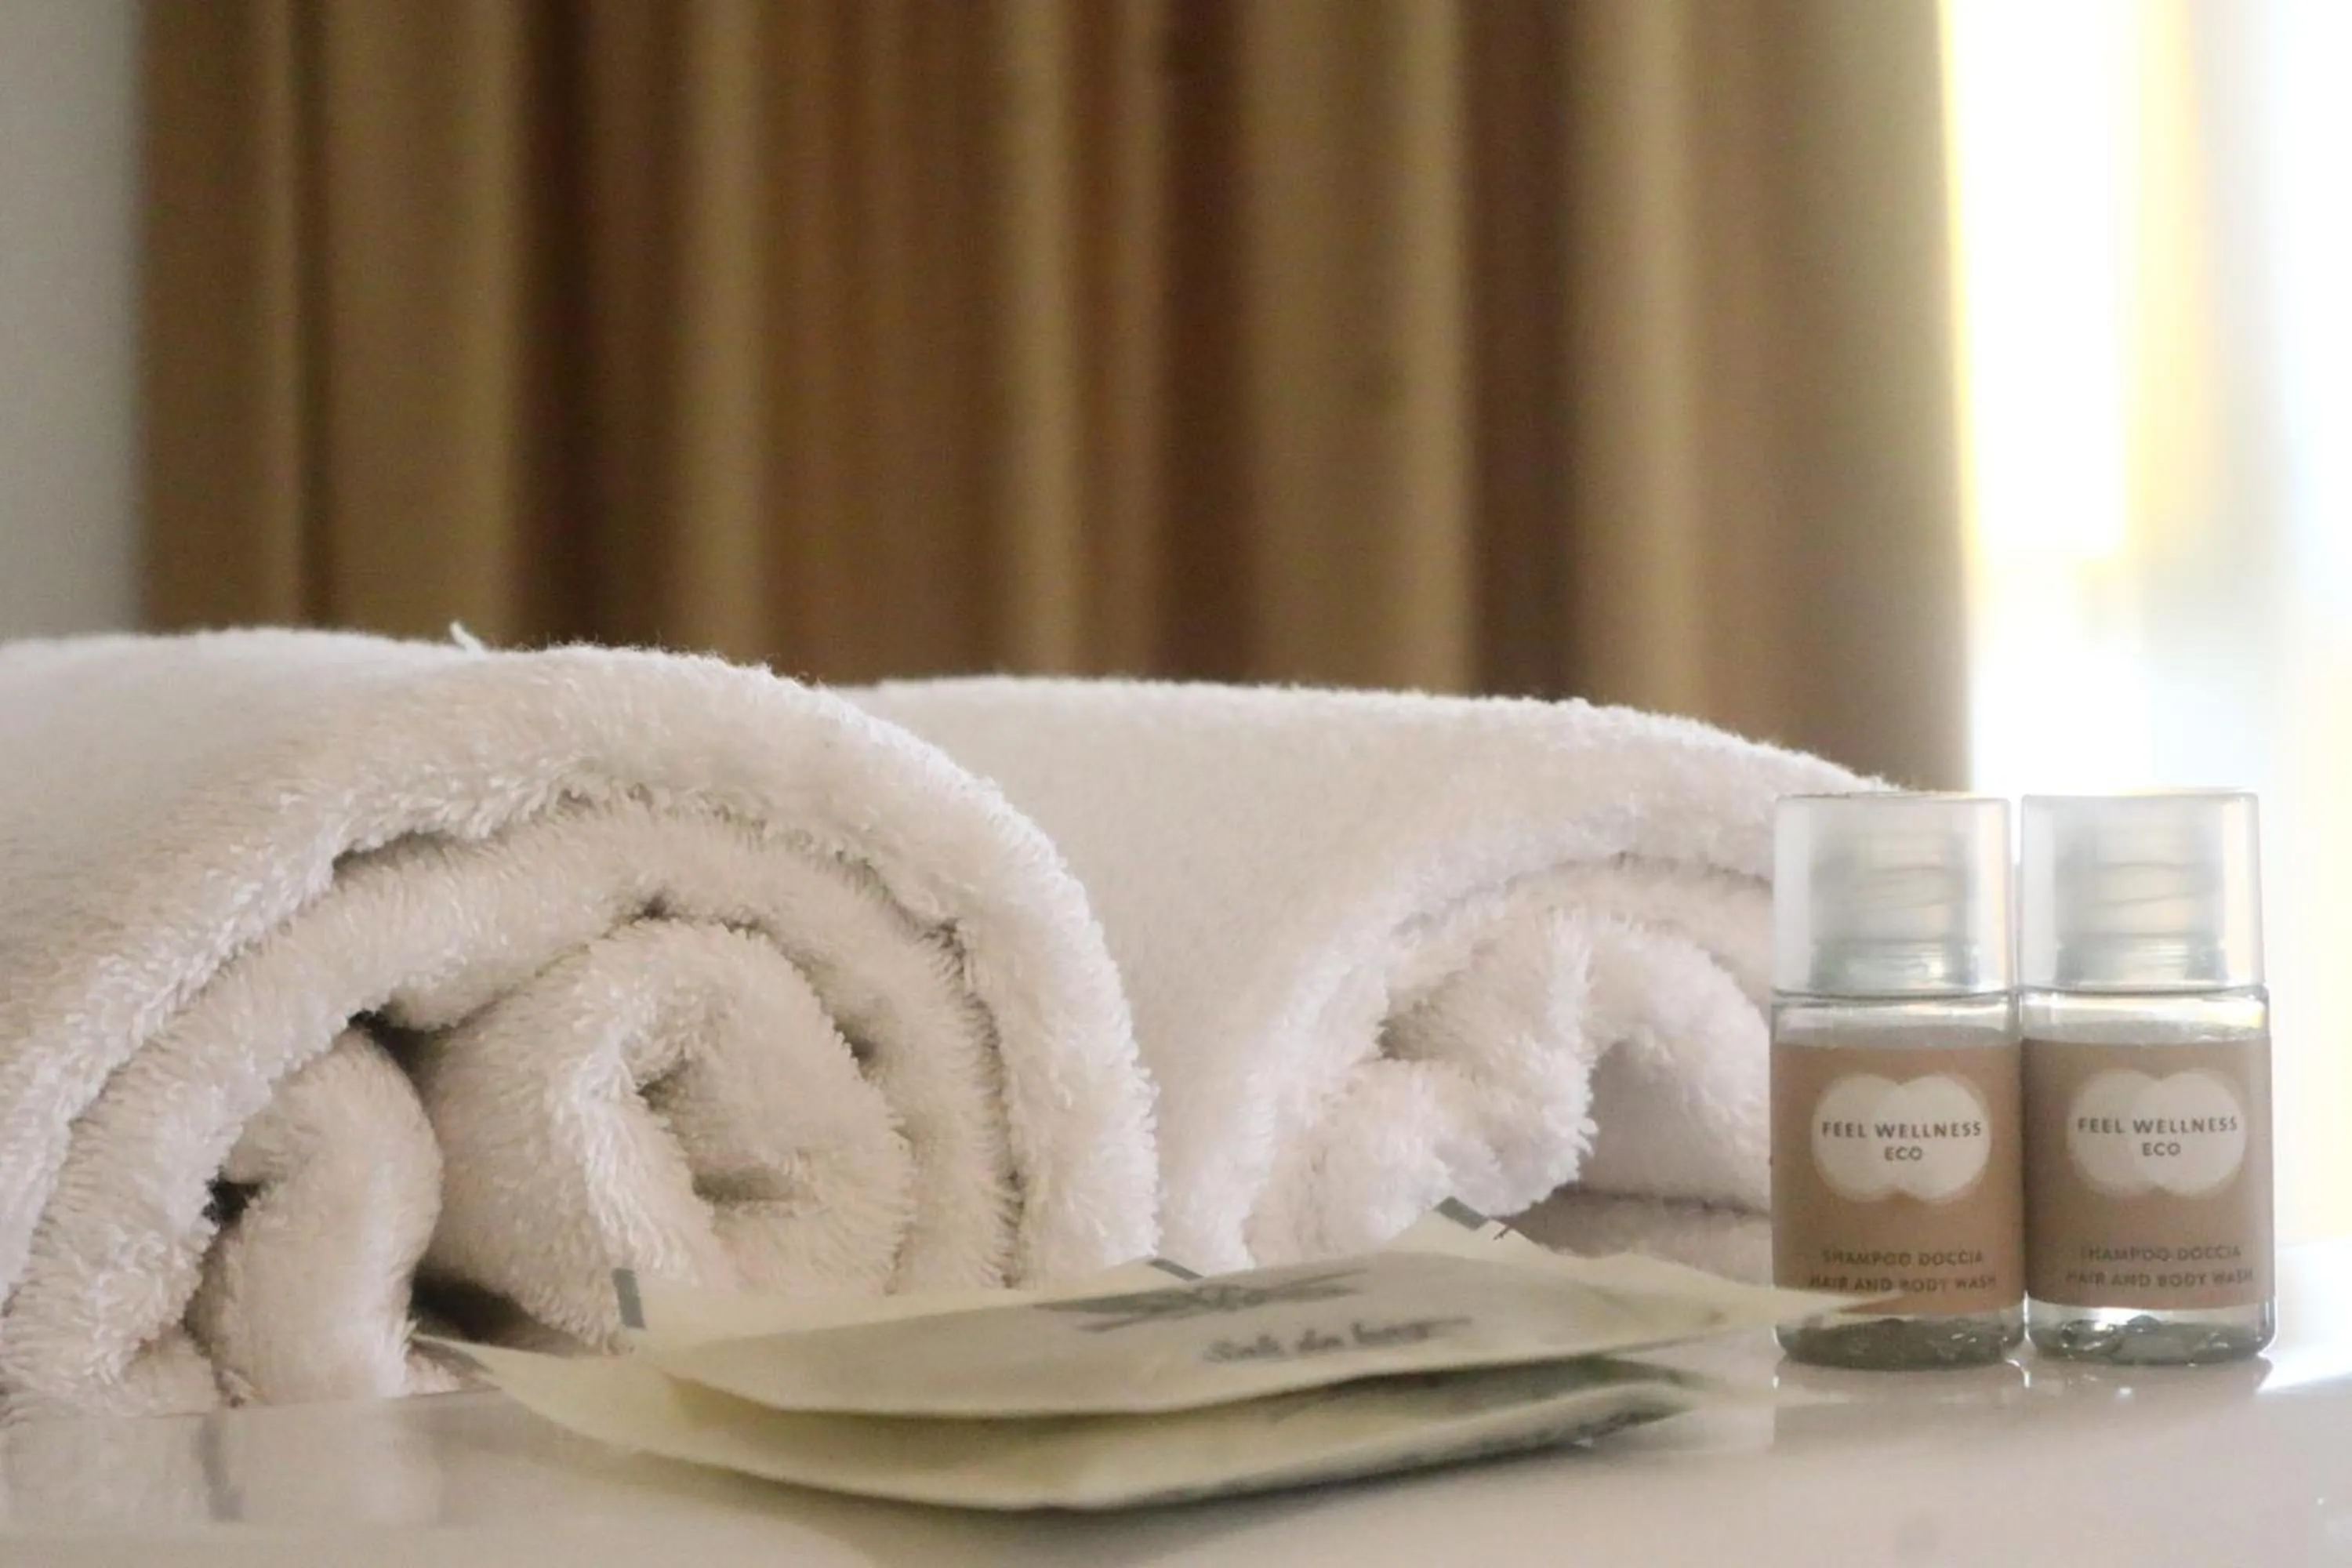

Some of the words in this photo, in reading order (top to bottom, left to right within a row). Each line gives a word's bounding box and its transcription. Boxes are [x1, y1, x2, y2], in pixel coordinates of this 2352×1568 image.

[1821, 1122, 1866, 1138] FEEL
[1875, 1120, 1981, 1138] WELLNESS
[2078, 1116, 2125, 1134] FEEL
[2132, 1116, 2238, 1134] WELLNESS
[1884, 1145, 1923, 1161] ECO
[2141, 1142, 2181, 1157] ECO
[1821, 1248, 1911, 1267] SHAMPOO
[1918, 1247, 1983, 1266] DOCCIA
[2176, 1243, 2241, 1261] DOCCIA
[1854, 1276, 1894, 1293] AND
[1900, 1278, 1946, 1293] BODY
[2065, 1270, 2106, 1286] HAIR
[2111, 1272, 2151, 1287] AND
[2156, 1272, 2206, 1287] BODY
